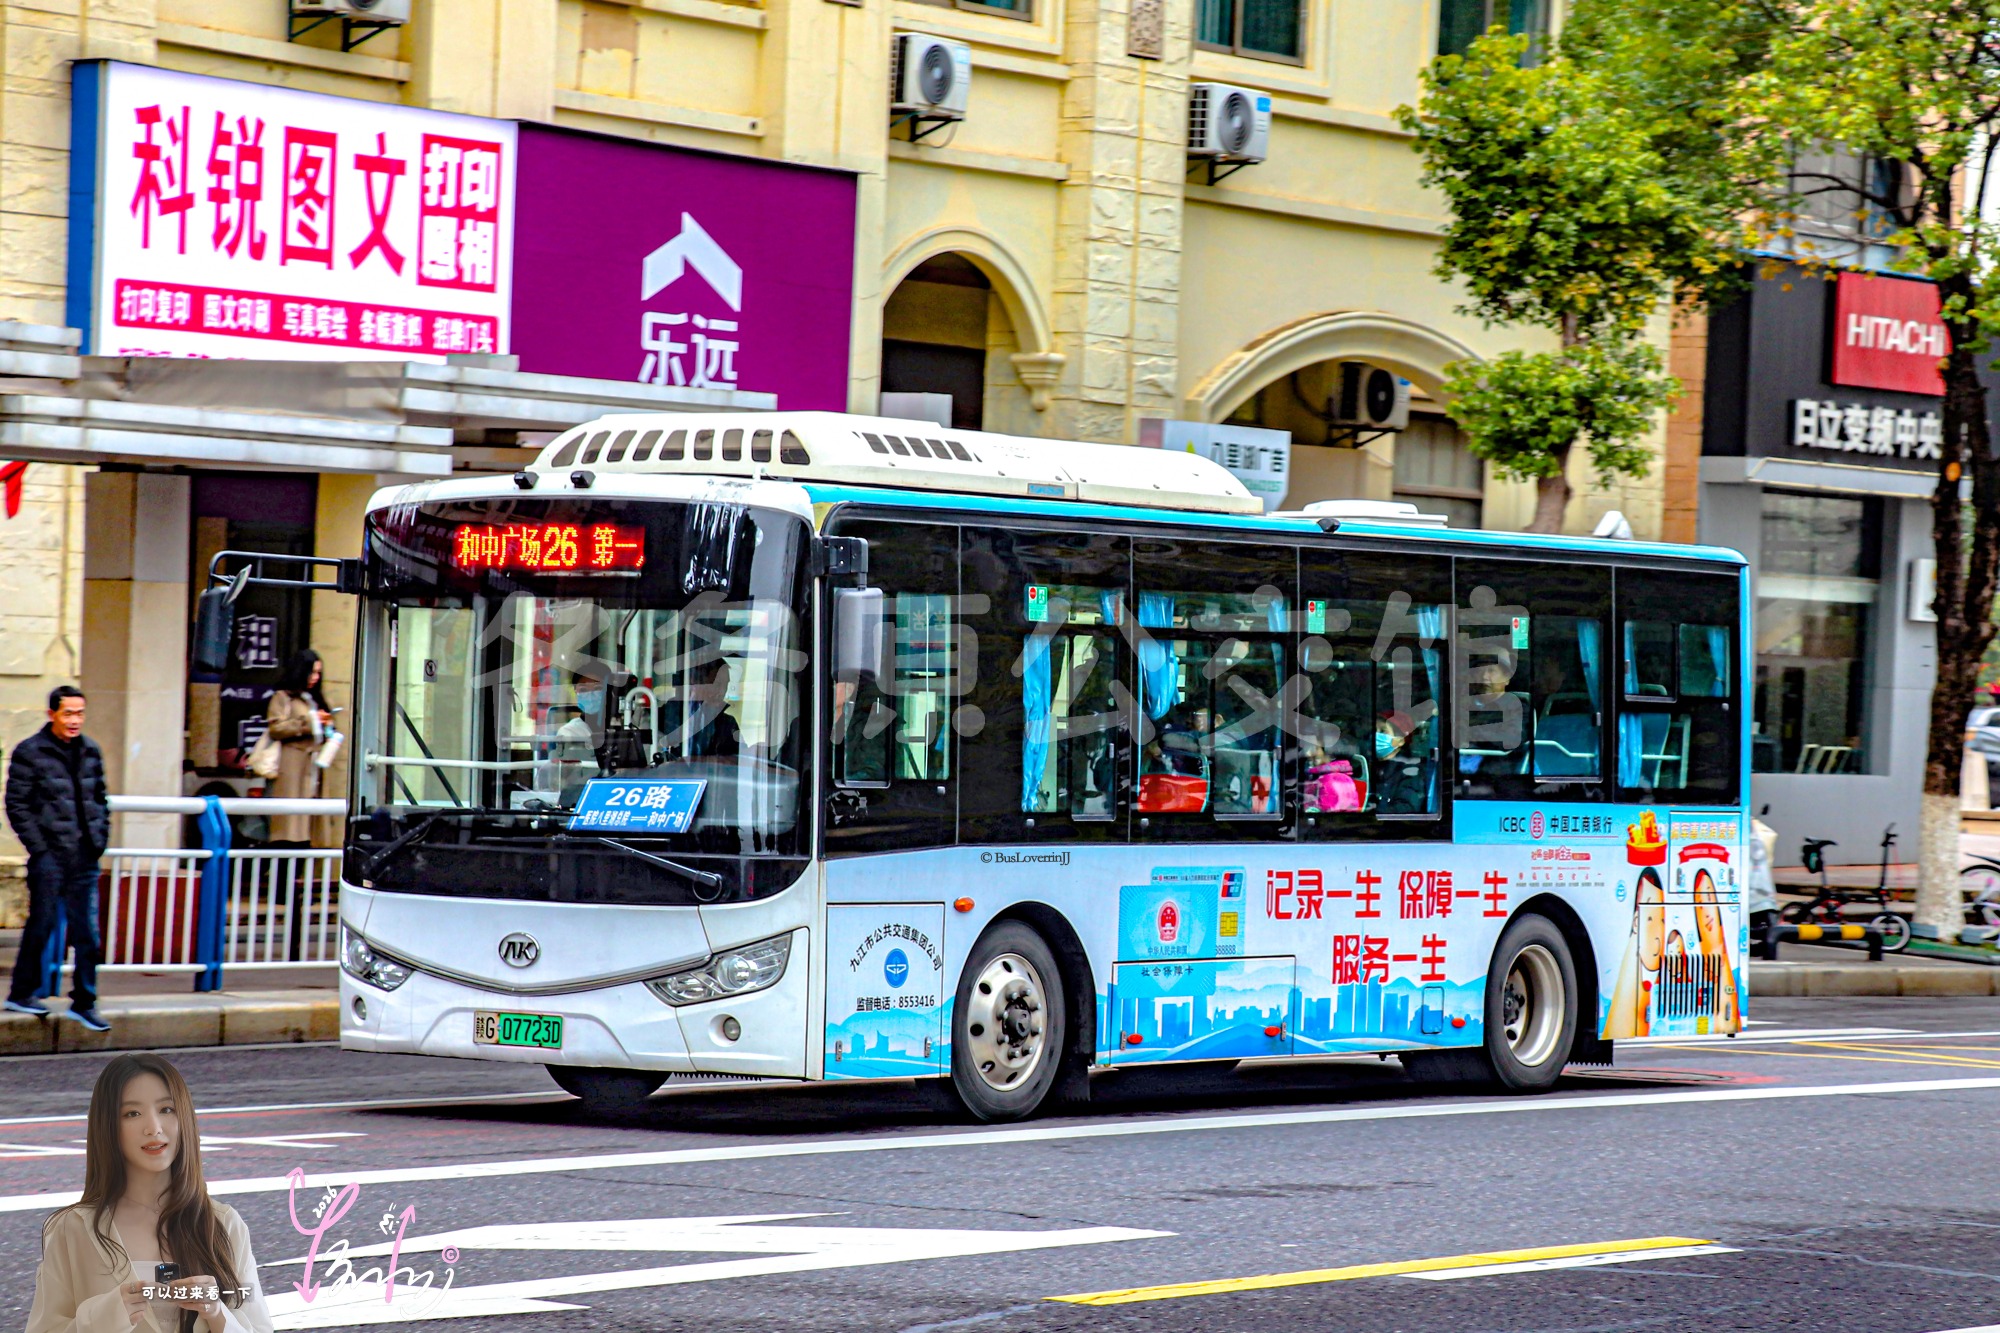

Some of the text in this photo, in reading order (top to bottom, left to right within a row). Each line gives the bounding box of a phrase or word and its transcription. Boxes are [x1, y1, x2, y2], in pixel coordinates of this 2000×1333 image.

[130, 104, 407, 277] 科锐图文
[423, 143, 498, 213] 打印
[420, 215, 496, 285] 照相
[121, 285, 191, 325] 打印复印
[203, 293, 271, 333] 图文印刷
[638, 311, 739, 389] 乐远
[1846, 313, 1945, 357] HITACHI
[1794, 399, 1943, 459] 日立变频中央
[592, 527, 644, 566] 第一
[605, 785, 672, 809] 26路
[647, 811, 686, 828] 和中广场
[1499, 815, 1613, 833] ICBC 中国工商银行
[1266, 869, 1508, 919] 记录一生 保障一生
[850, 923, 943, 972] 九江市公共交通集团公司
[1141, 965, 1194, 977] 社会保障卡
[1332, 933, 1447, 984] 服务一生
